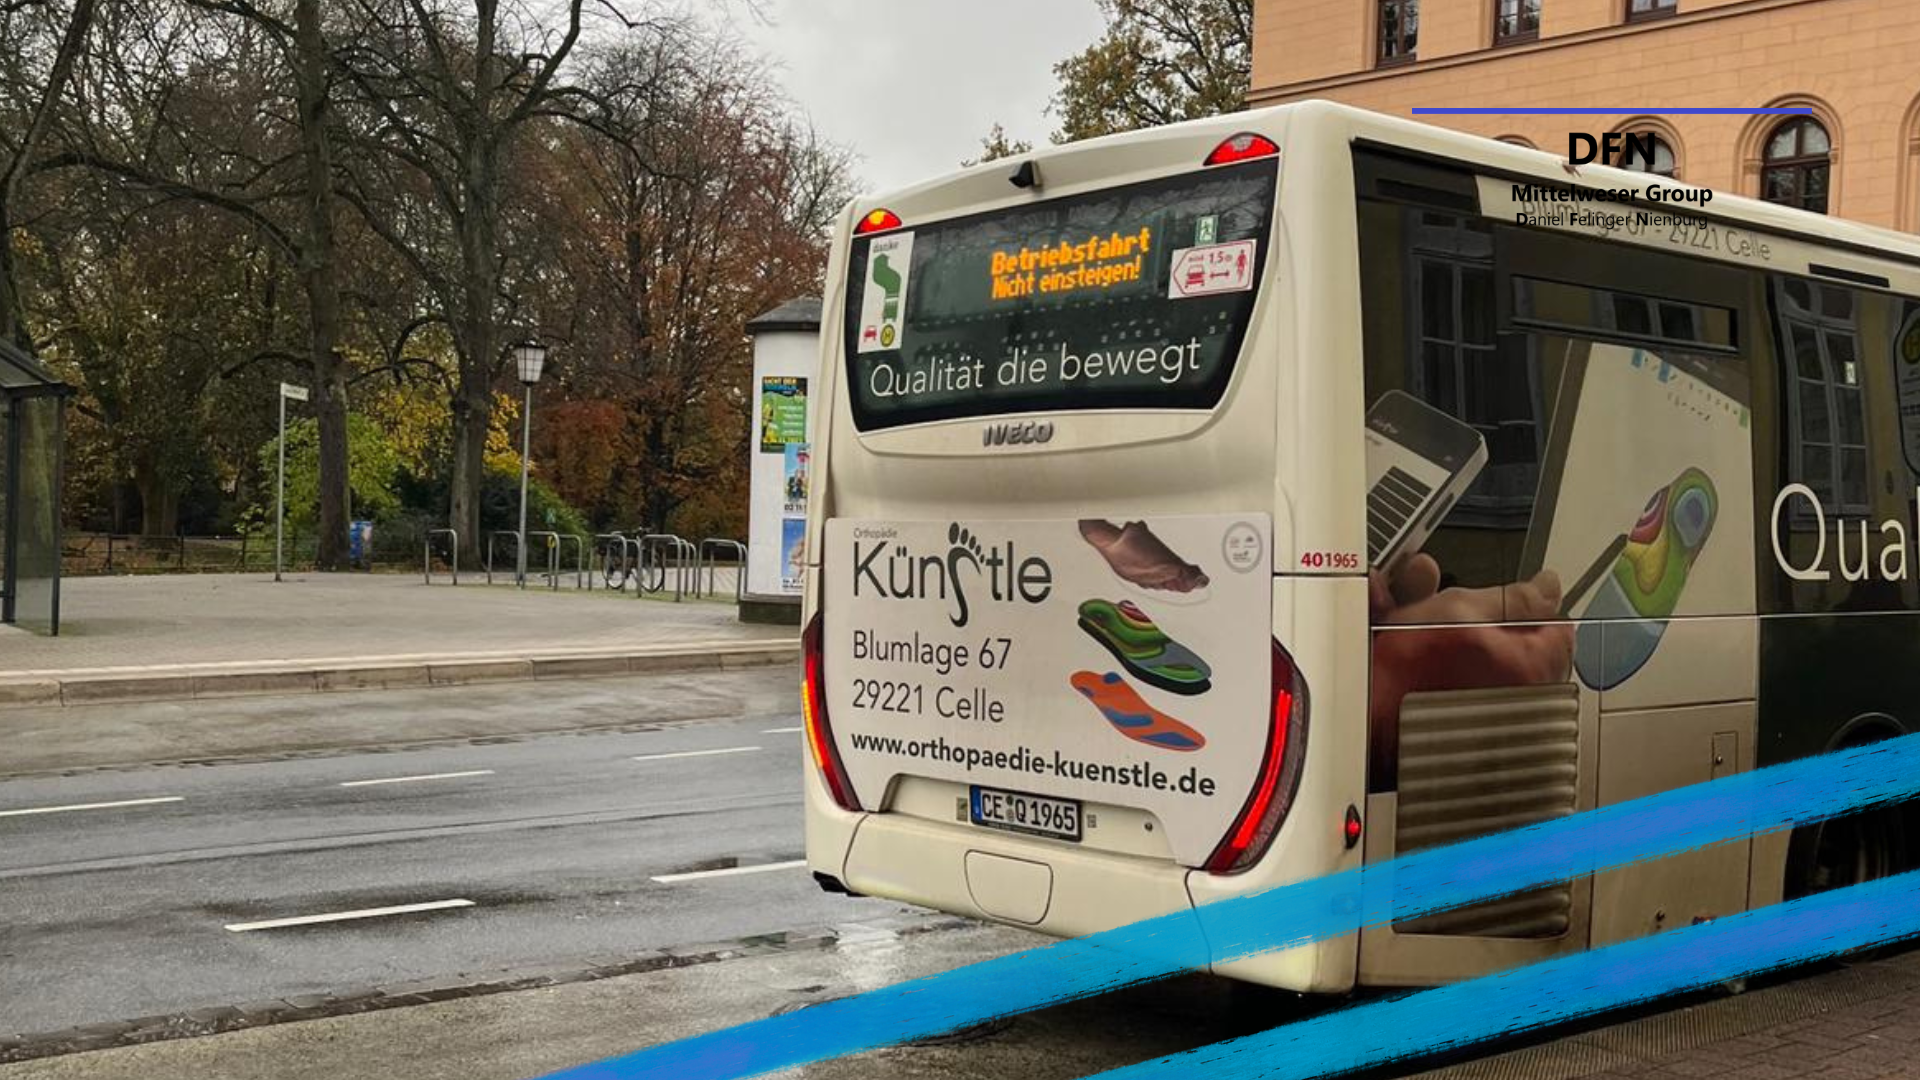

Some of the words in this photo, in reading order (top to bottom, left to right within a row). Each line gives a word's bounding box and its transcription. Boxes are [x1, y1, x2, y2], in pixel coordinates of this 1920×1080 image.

[991, 226, 1150, 275] Betriebsfahrt
[1725, 231, 1771, 260] Celle
[992, 272, 1035, 299] Nicht
[1039, 255, 1141, 292] einsteigen!
[870, 354, 985, 397] Qualität
[997, 347, 1048, 386] die
[1059, 337, 1201, 383] bewegt
[982, 421, 1054, 447] IVECO
[853, 527, 898, 539] Orthopädie
[853, 534, 1052, 627] Künstle
[1301, 552, 1358, 568] 401965
[853, 629, 969, 675] Blumlage
[978, 637, 1012, 670] 67
[852, 679, 922, 715] 29221
[935, 686, 1004, 723] Celle
[851, 732, 1216, 796] www.orthopaedie-kuenstle.de
[982, 794, 1004, 820] CE
[1030, 801, 1075, 831] 1965
